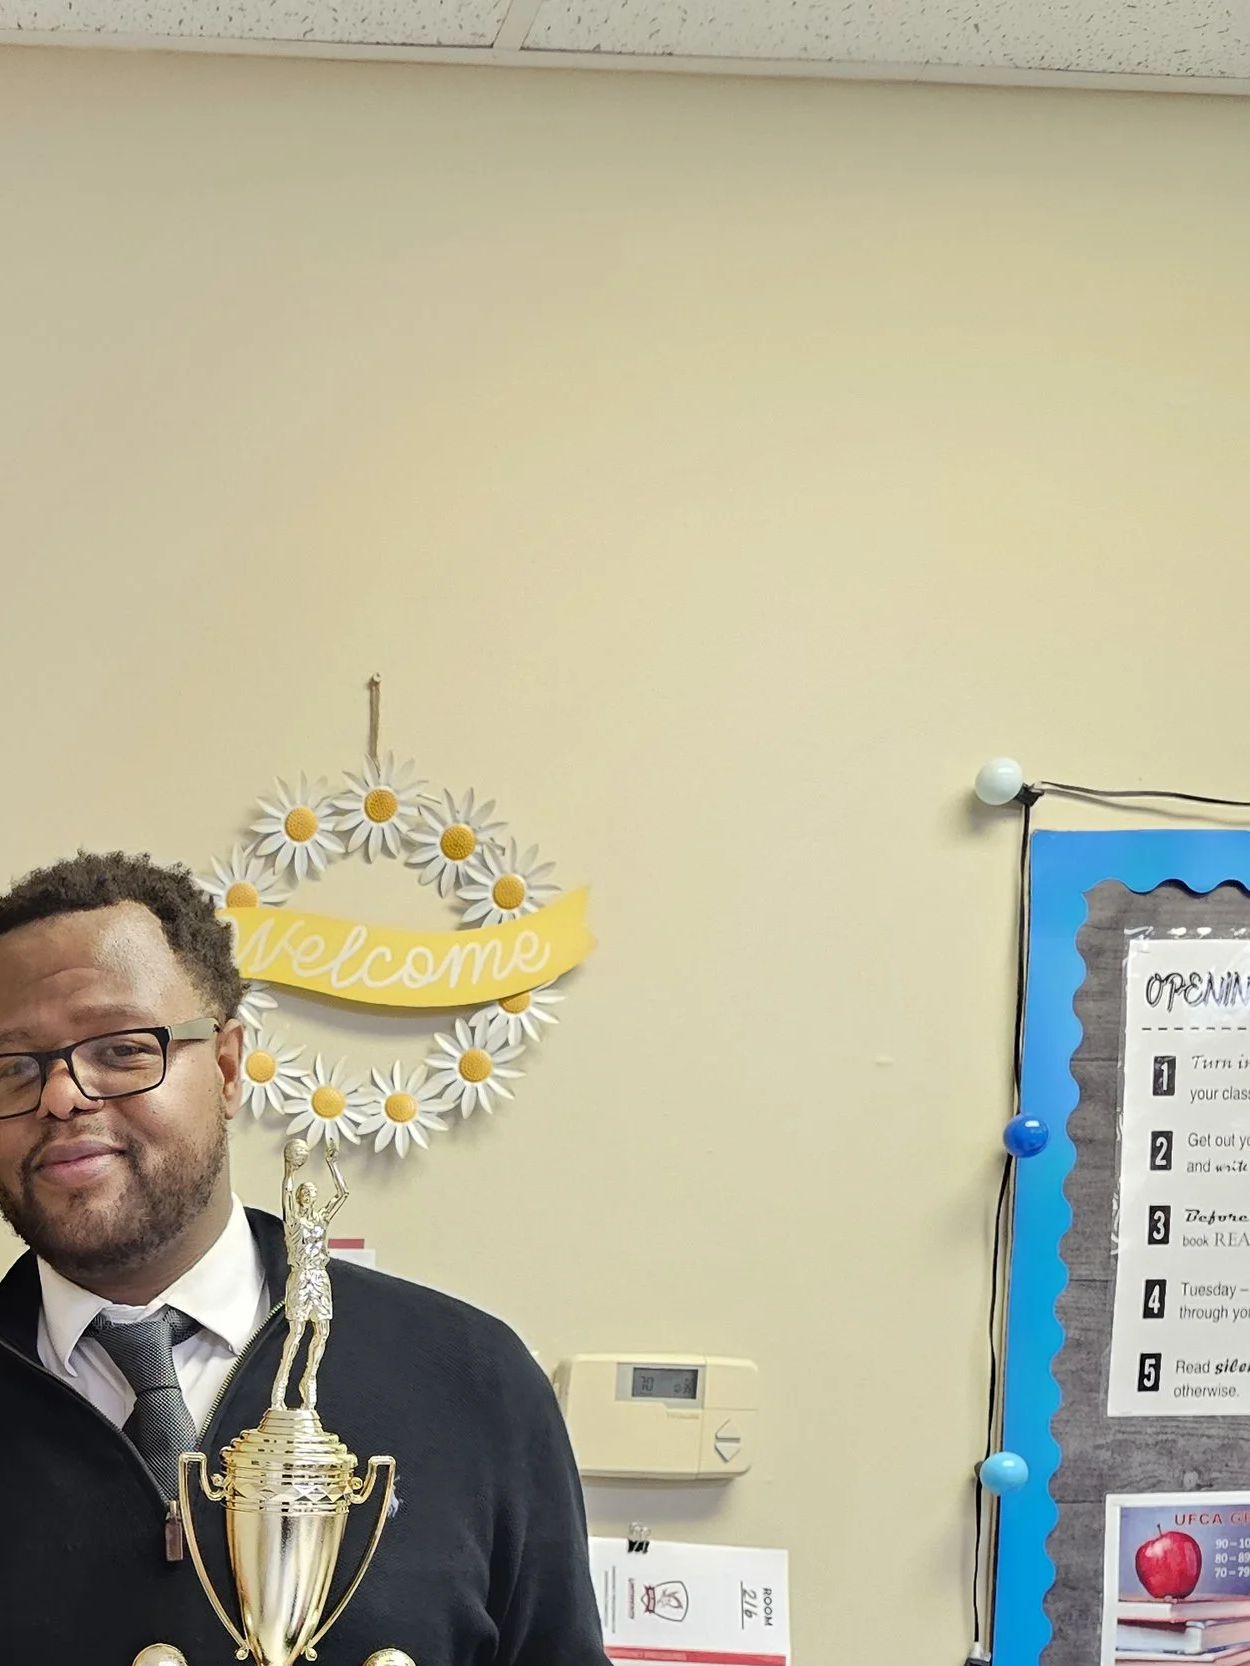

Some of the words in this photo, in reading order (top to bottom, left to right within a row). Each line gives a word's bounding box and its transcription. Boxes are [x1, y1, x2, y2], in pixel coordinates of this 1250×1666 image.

[233, 917, 550, 989] Welcome
[1191, 1054, 1232, 1070] Turn
[1190, 1088, 1219, 1105] your
[1222, 1086, 1250, 1101] clas
[1188, 1132, 1211, 1148] Get
[1215, 1133, 1235, 1148] out
[1155, 1136, 1169, 1166] 2
[1186, 1158, 1211, 1174] and
[1152, 1210, 1166, 1241] 3
[1185, 1208, 1249, 1226] Before
[1182, 1233, 1209, 1248] book
[1148, 1284, 1161, 1315] 4
[1181, 1281, 1237, 1300] Tuesday
[1179, 1304, 1228, 1324] through
[1143, 1358, 1156, 1388] 5
[1176, 1359, 1210, 1374] Read
[1173, 1383, 1240, 1398] otherwise.
[742, 1588, 758, 1620] 216
[762, 1587, 774, 1627] ROOM
